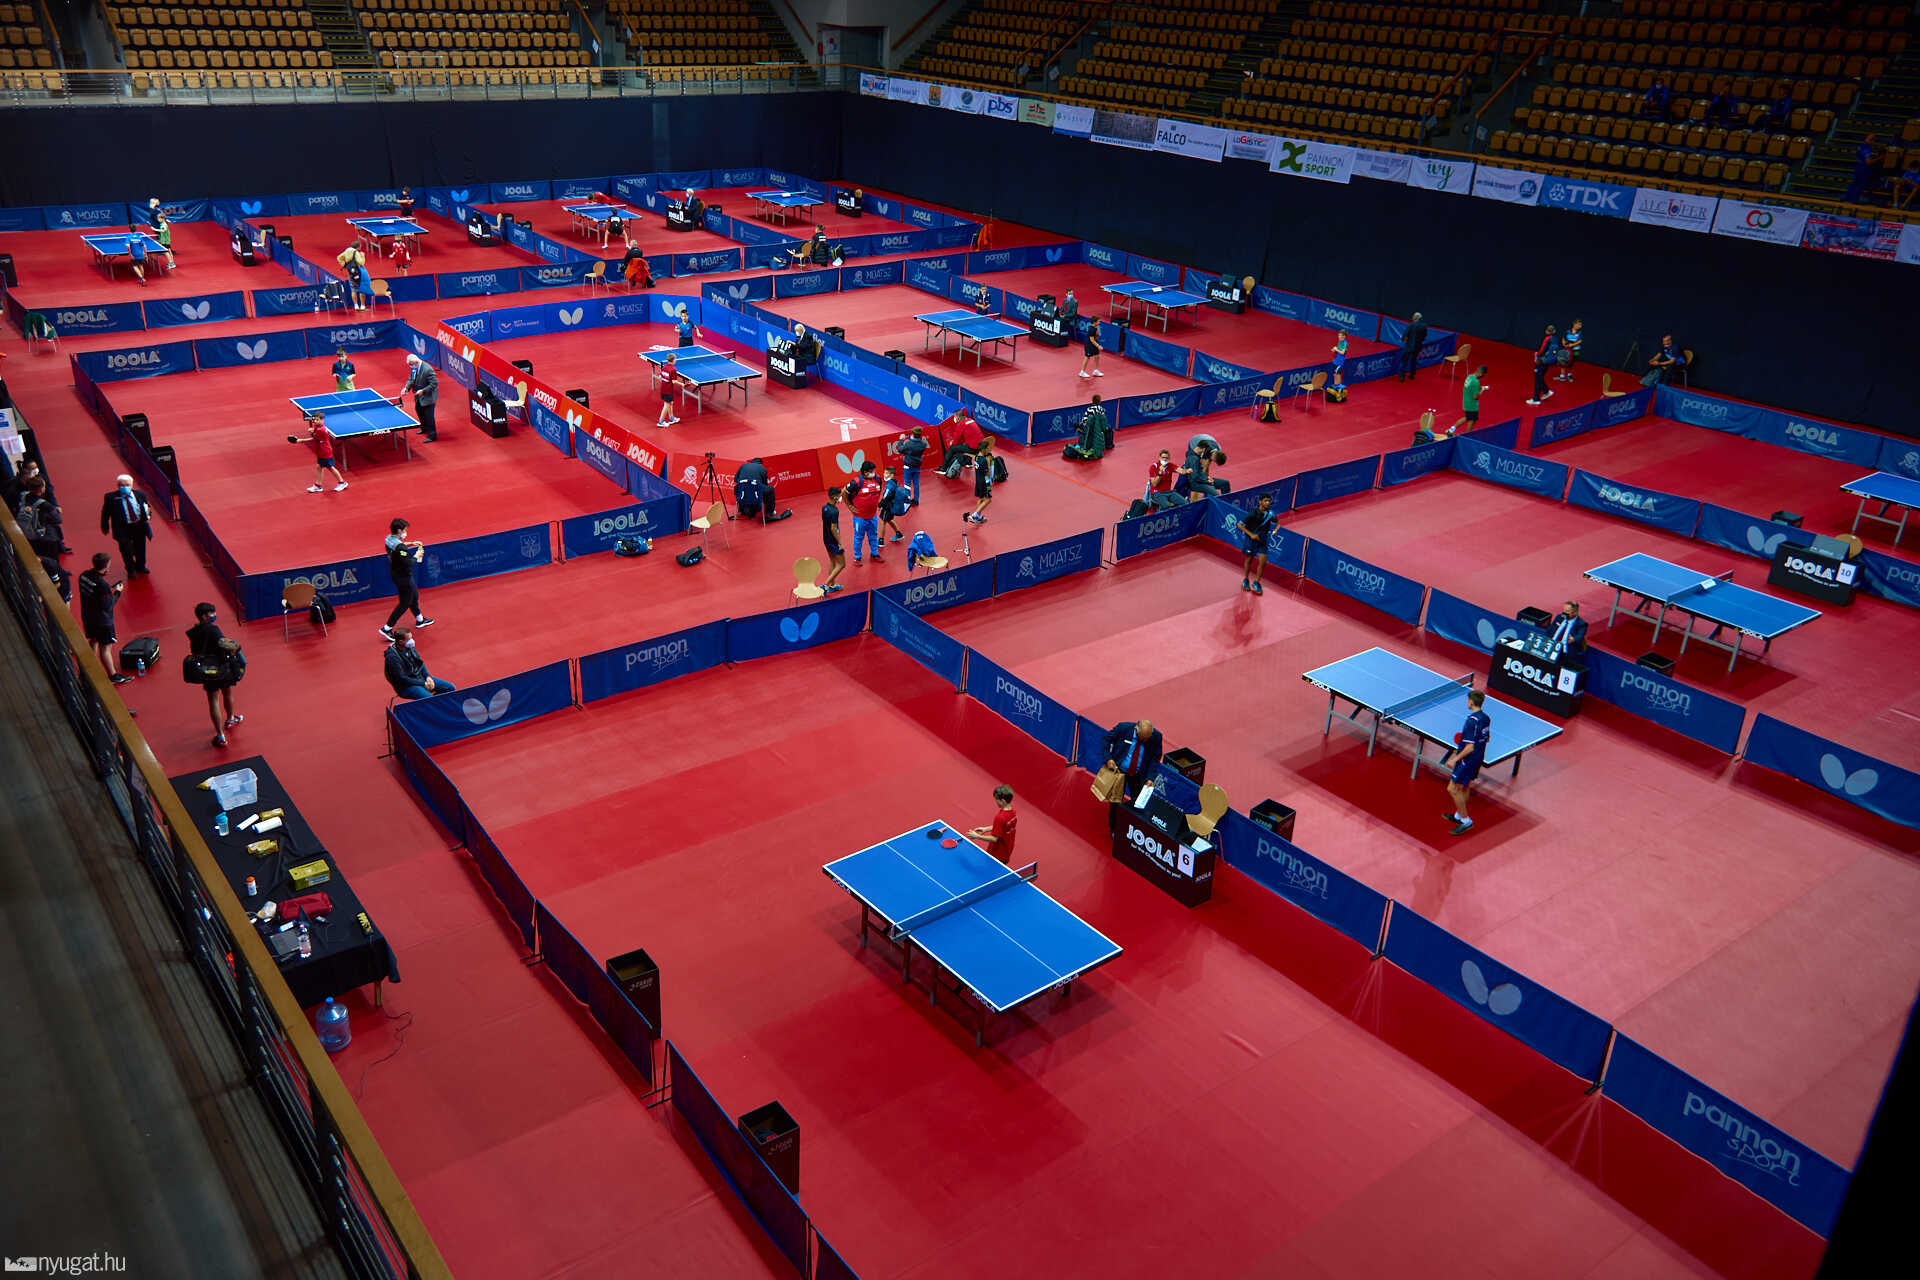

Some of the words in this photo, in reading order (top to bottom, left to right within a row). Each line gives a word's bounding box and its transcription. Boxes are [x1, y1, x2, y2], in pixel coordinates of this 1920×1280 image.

[988, 97, 1013, 114] pbs
[1157, 131, 1186, 145] FALCO
[1307, 152, 1344, 167] PANNON
[1305, 164, 1336, 176] SPORT
[1427, 160, 1455, 190] ivy
[374, 193, 397, 204] JOOL
[505, 186, 533, 195] JOOLA
[1566, 185, 1621, 209] TDK
[912, 209, 931, 221] JOOLA
[882, 235, 909, 247] JOOLA
[1090, 248, 1111, 263] JOOLA
[462, 273, 496, 287] pannon
[538, 266, 573, 280] JOOLA
[1212, 289, 1231, 300] JOOLA
[57, 310, 109, 325] JOOLA
[1034, 319, 1054, 332] JOOLA
[1325, 308, 1355, 325] JOOLA
[331, 328, 376, 343] JOOLA
[437, 329, 454, 348] JOOLA
[108, 351, 161, 368] JOOLA
[771, 356, 788, 371] JOOLA
[825, 355, 848, 375] JOOLA
[1209, 362, 1241, 381] JOOLA
[534, 388, 557, 411] pannon
[1139, 395, 1176, 413] JOOLA
[1681, 398, 1727, 417] pannon
[975, 401, 1007, 423] JOOLA
[1786, 421, 1838, 446] JOOLA
[586, 439, 611, 465] JOOLA
[627, 443, 656, 470] JOOLA
[702, 471, 736, 486] MATSZ
[1496, 458, 1544, 482] MOATSZ
[1598, 485, 1655, 511] JOOLA
[594, 510, 648, 536] JOOLA
[1137, 515, 1180, 538] JOOLA
[1040, 544, 1082, 570] MOATSZ
[1336, 559, 1385, 590] pannon
[1784, 556, 1833, 580] JOOLA
[1841, 568, 1851, 577] 10
[1887, 566, 1920, 583] pan
[904, 576, 957, 605] JOOLA
[1534, 639, 1541, 648] 3
[626, 638, 688, 670] pannon
[652, 651, 690, 672] sport
[1503, 657, 1554, 688] JOOLA
[1563, 676, 1570, 685] 8
[996, 675, 1042, 713] pannon
[1621, 671, 1691, 708] pannon
[1014, 700, 1043, 722] sport
[1646, 693, 1691, 717] sport
[1126, 824, 1174, 868] JOOLA
[1182, 853, 1190, 866] 6
[1256, 837, 1328, 889] pannon
[1284, 869, 1328, 900] sport
[1054, 973, 1079, 990] JOOLA
[1683, 1091, 1801, 1172] pannon
[1727, 1137, 1800, 1187] sport
